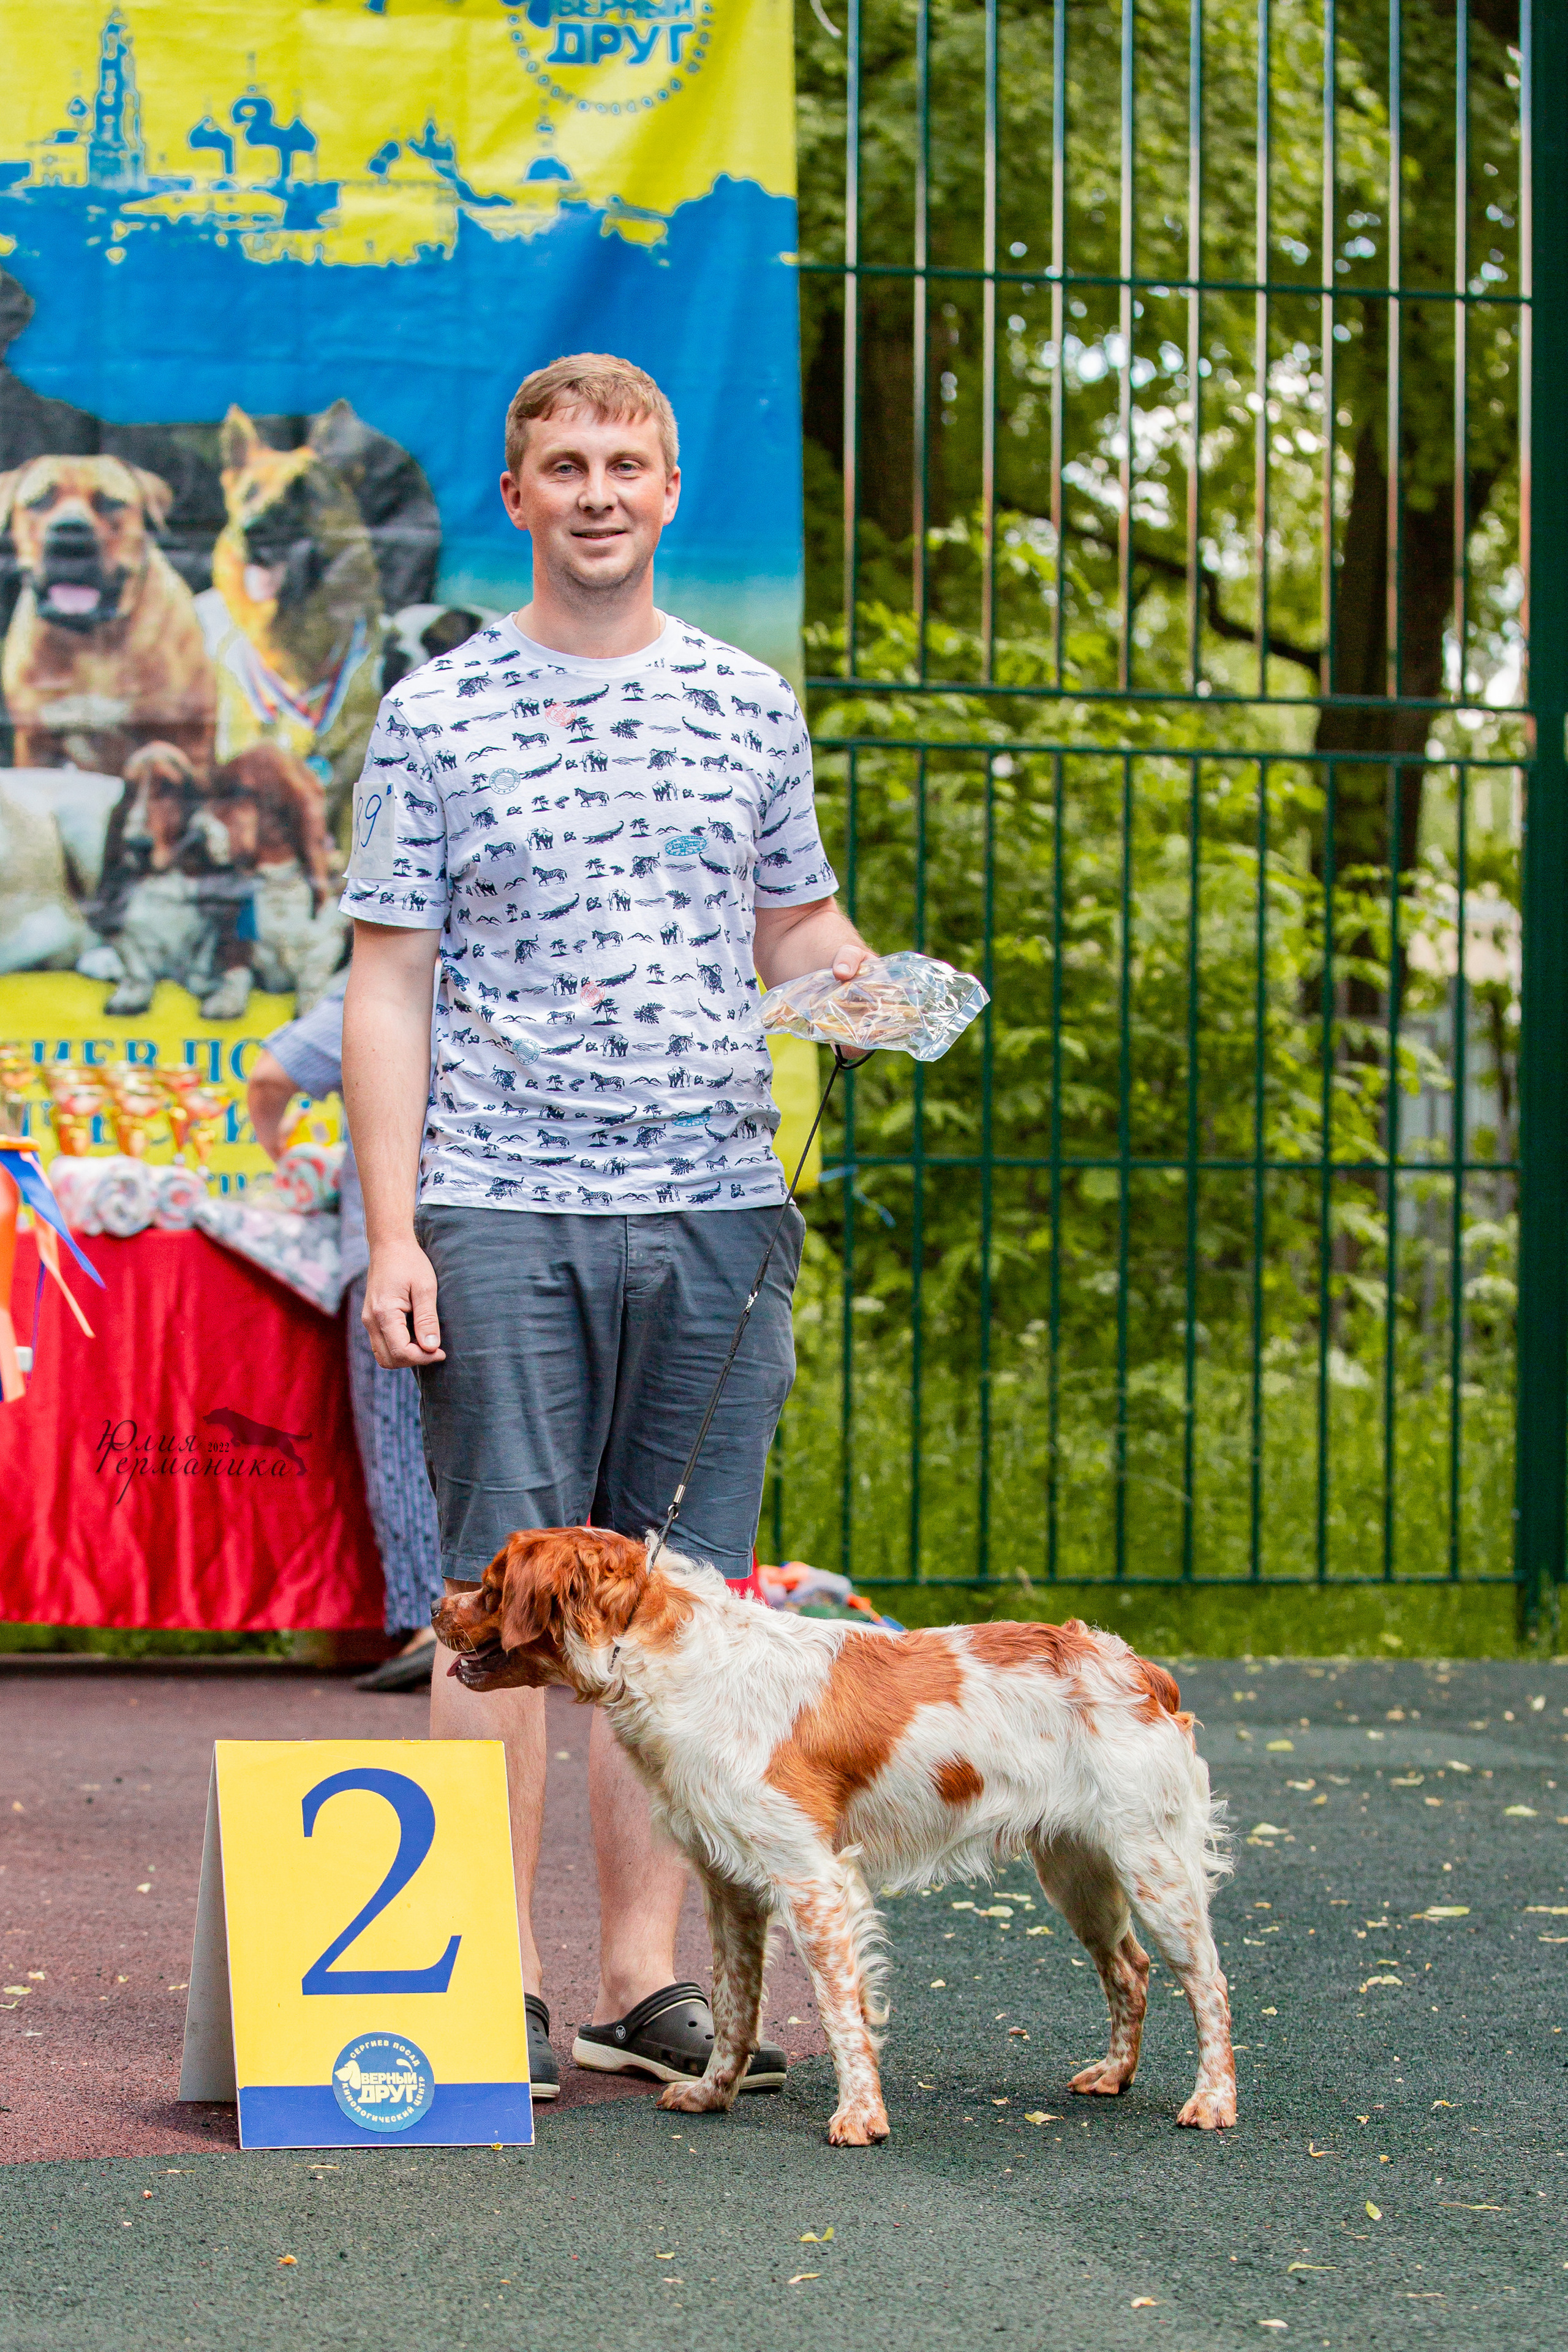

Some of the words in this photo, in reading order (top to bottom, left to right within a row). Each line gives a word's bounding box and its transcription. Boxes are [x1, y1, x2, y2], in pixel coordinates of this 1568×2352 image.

[545, 21, 695, 66] ДРУГ
[301, 1767, 462, 1996] 2
[350, 2040, 389, 2059] СЕРГИЕВ
[393, 2042, 421, 2067] ПОСАД
[357, 2084, 418, 2103] ДРУГ
[361, 2072, 418, 2084] ВЕРНЫЙ
[341, 2082, 415, 2124] КИНОЛОГИЧЕСКИЙ
[413, 2076, 426, 2106] ЦЕНТР
